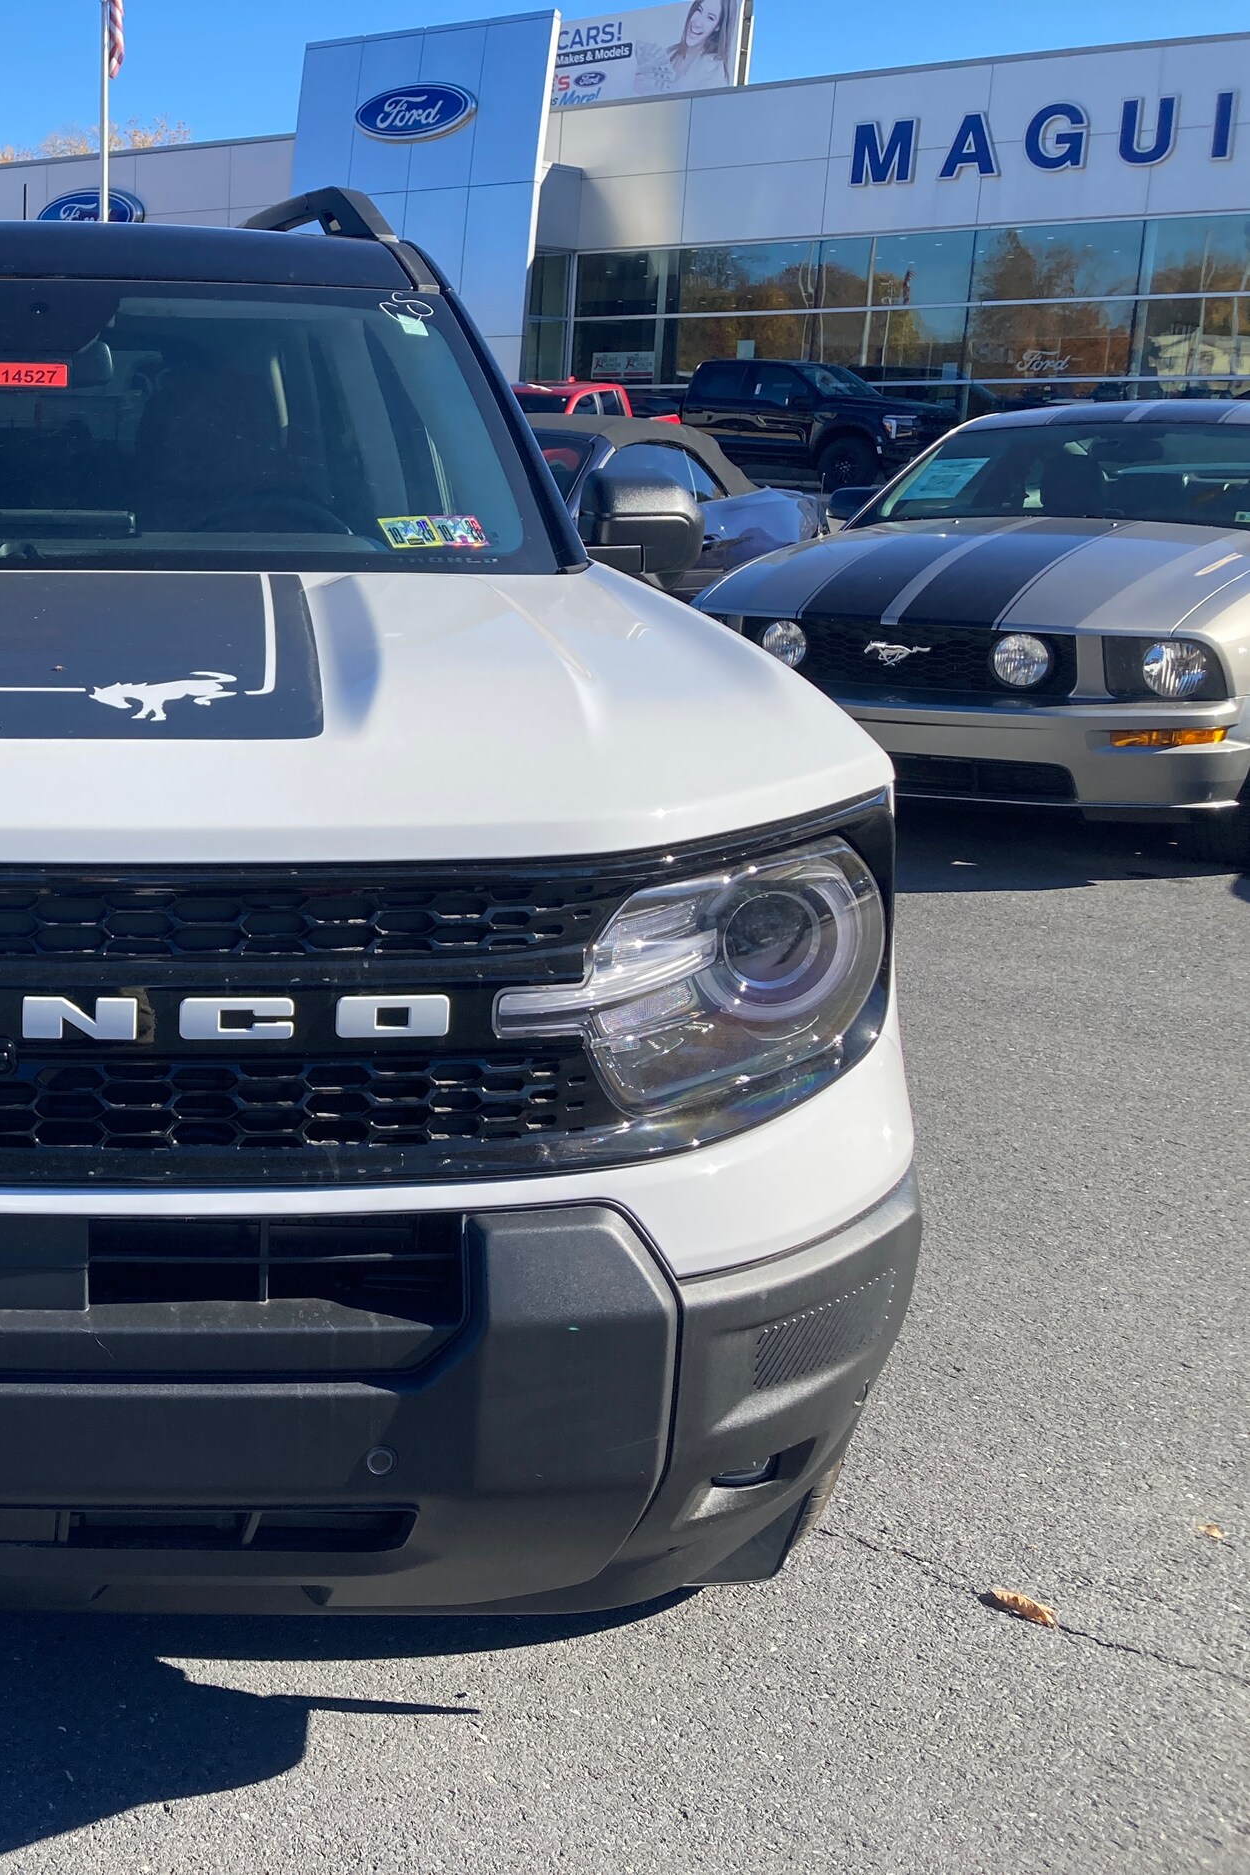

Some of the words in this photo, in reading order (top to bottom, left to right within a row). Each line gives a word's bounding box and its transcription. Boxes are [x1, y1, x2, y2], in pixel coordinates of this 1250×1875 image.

[558, 21, 622, 50] CARS!
[586, 50, 594, 61] &
[595, 46, 630, 60] Models
[559, 87, 602, 106] More!
[376, 95, 444, 128] Ford
[849, 90, 1240, 187] MAGUI
[1015, 350, 1071, 371] Ford
